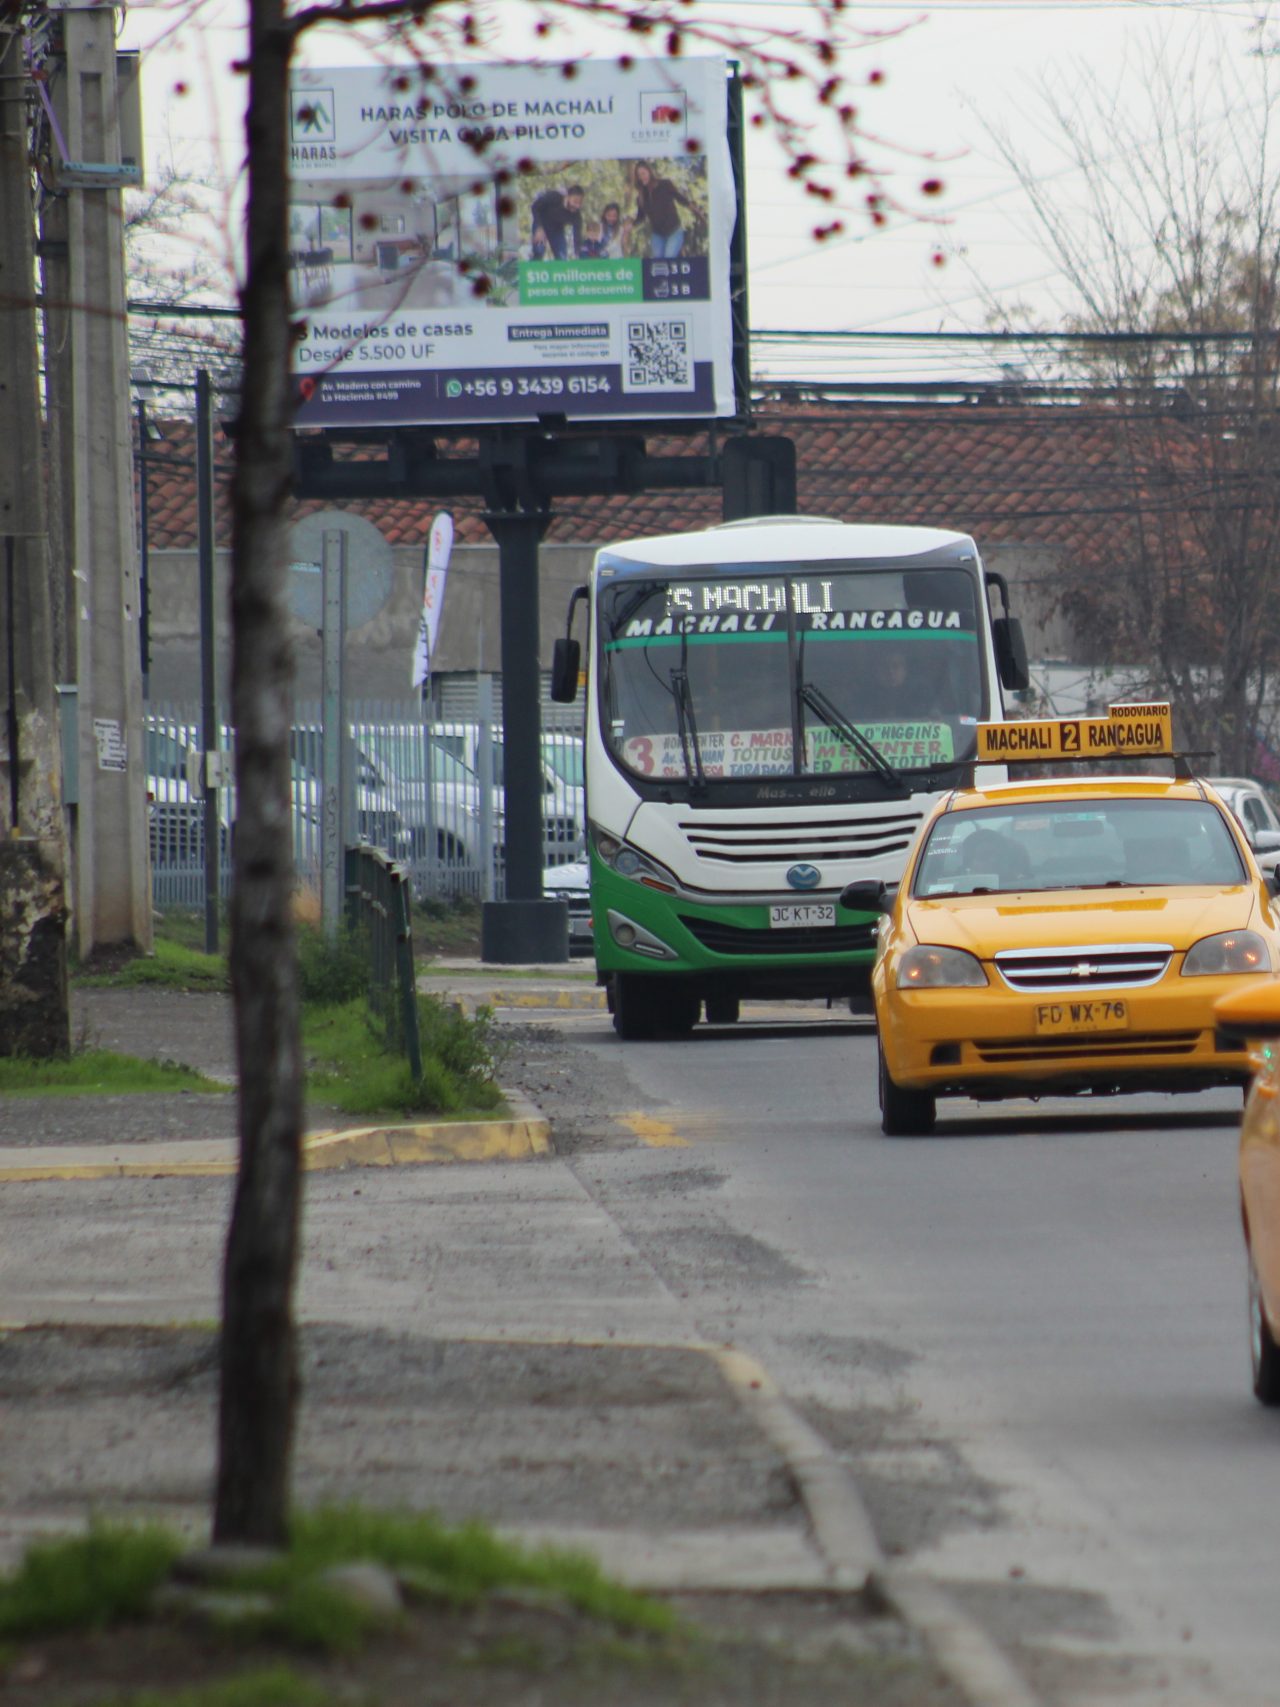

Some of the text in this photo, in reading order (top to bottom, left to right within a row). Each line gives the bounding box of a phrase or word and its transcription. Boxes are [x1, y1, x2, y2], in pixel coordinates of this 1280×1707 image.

[361, 96, 614, 121] HARAS POLO DE MACHALÍ
[389, 128, 451, 144] VISITA
[515, 124, 585, 141] PILOTO
[291, 146, 337, 160] HARAS
[526, 268, 634, 284] $10 millones de
[671, 263, 691, 274] 3 D
[527, 284, 635, 298] pesos de descuento
[671, 285, 691, 296] 3 B
[313, 323, 389, 340] Modelos
[395, 323, 417, 338] de
[423, 324, 473, 337] casas
[512, 327, 552, 340] Entrega
[300, 343, 436, 363] Desde 5.500 UF
[336, 380, 369, 391] Madero
[371, 381, 387, 390] con
[388, 379, 422, 389] camino
[465, 376, 611, 397] +56 9 3439 6154
[626, 611, 961, 638] MACHALI RANCAGUA
[1111, 705, 1168, 718] RODOVIARIO
[986, 723, 1163, 751] MACHALI 2 RANCAGUA
[628, 735, 655, 776] 3
[732, 747, 792, 762] TOTTUS
